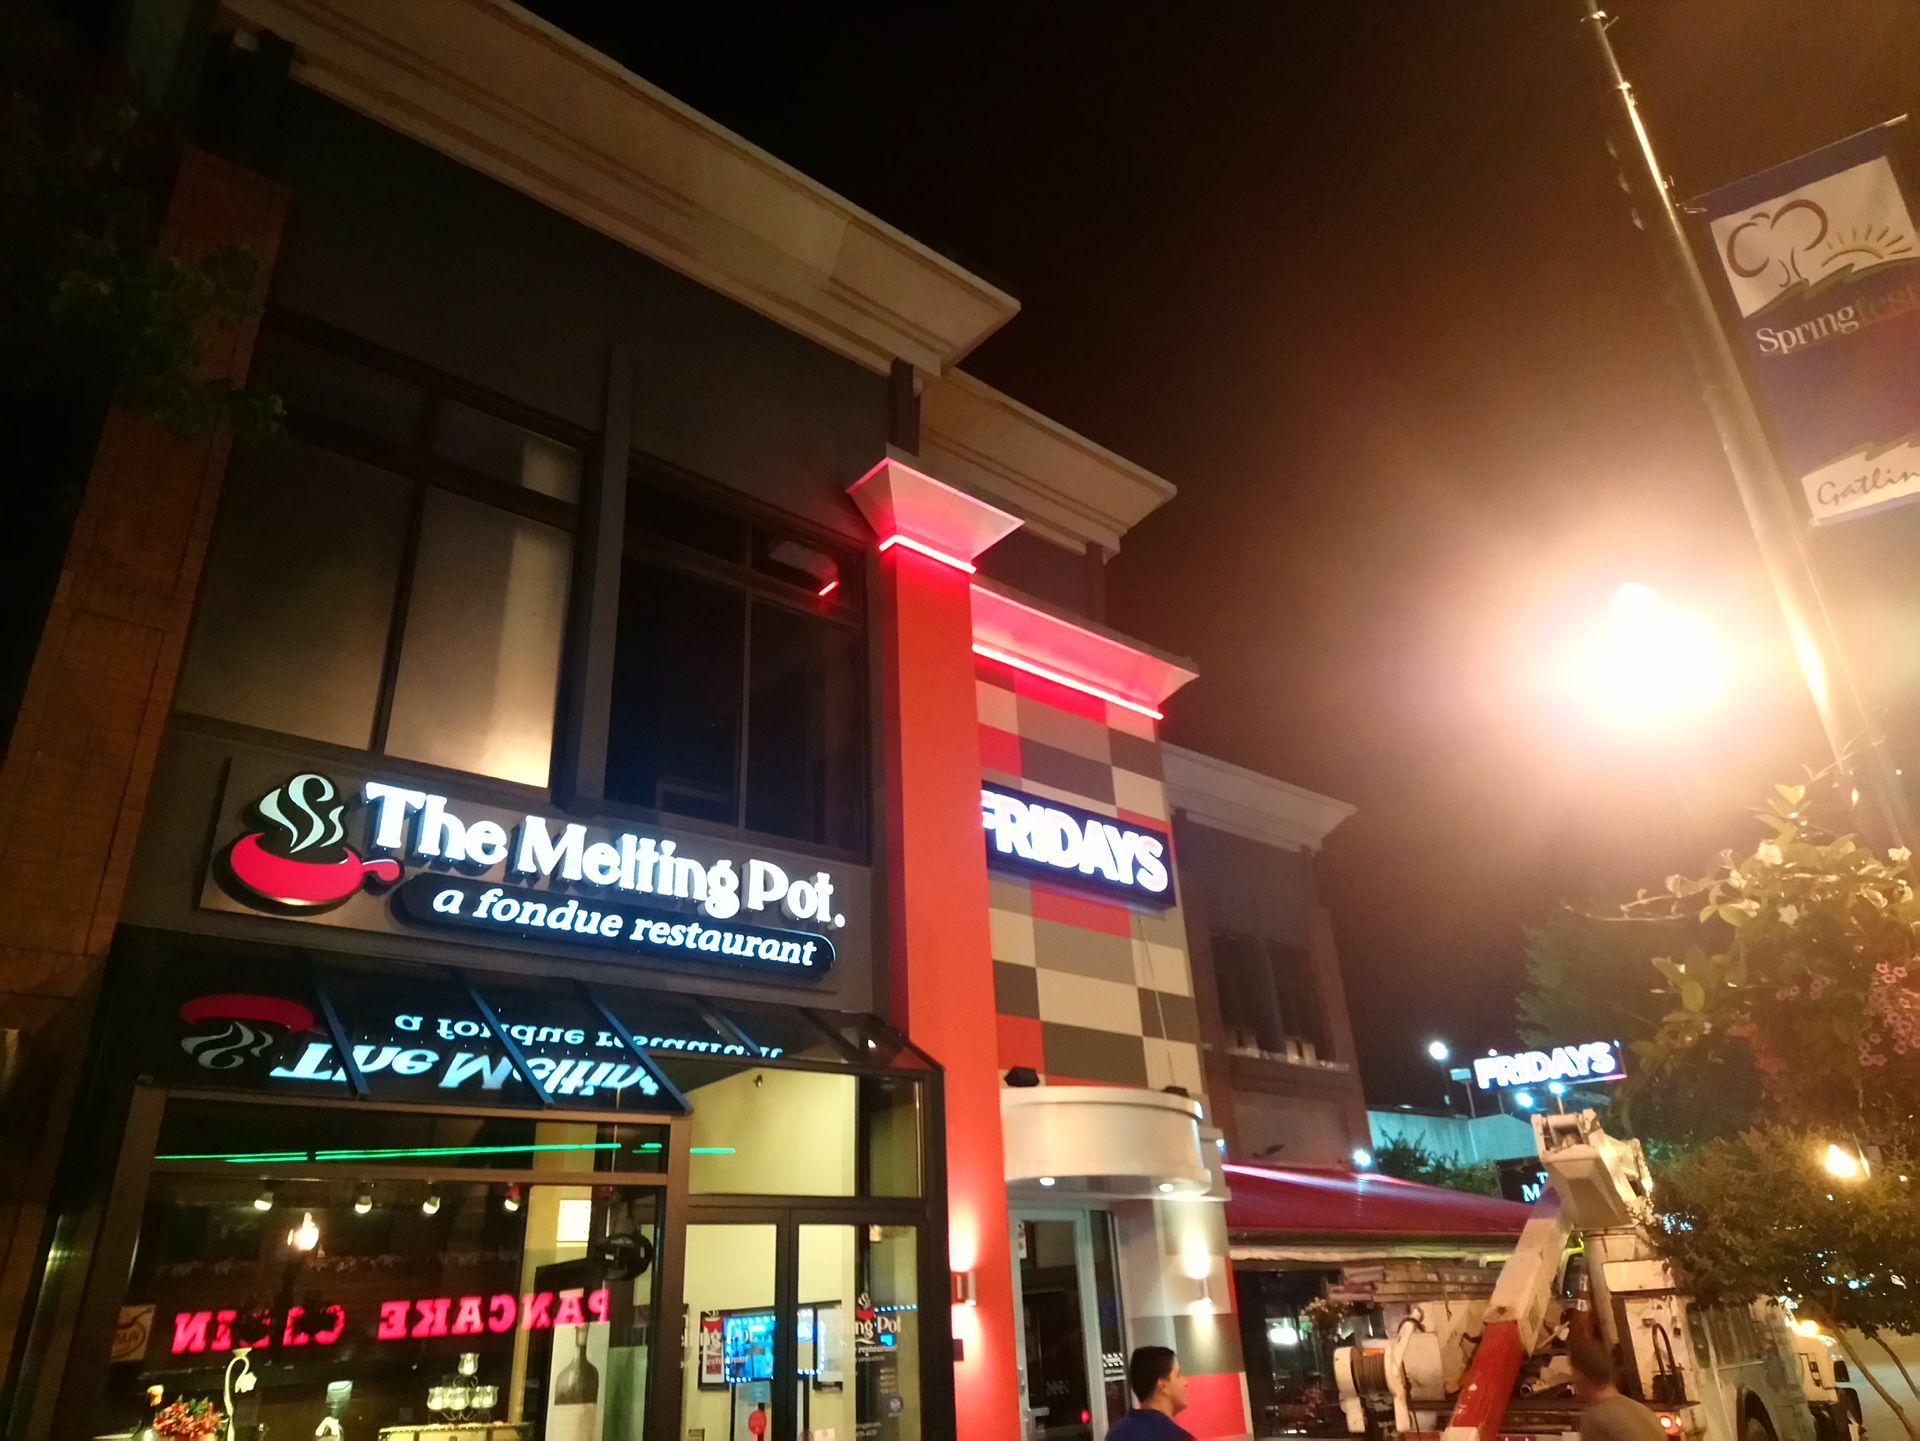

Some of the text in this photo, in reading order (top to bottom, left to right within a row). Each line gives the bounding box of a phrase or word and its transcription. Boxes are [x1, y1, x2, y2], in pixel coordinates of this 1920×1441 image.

[365, 782, 508, 866] The
[517, 815, 741, 919] Melting
[432, 888, 818, 967] a fondue restaurant
